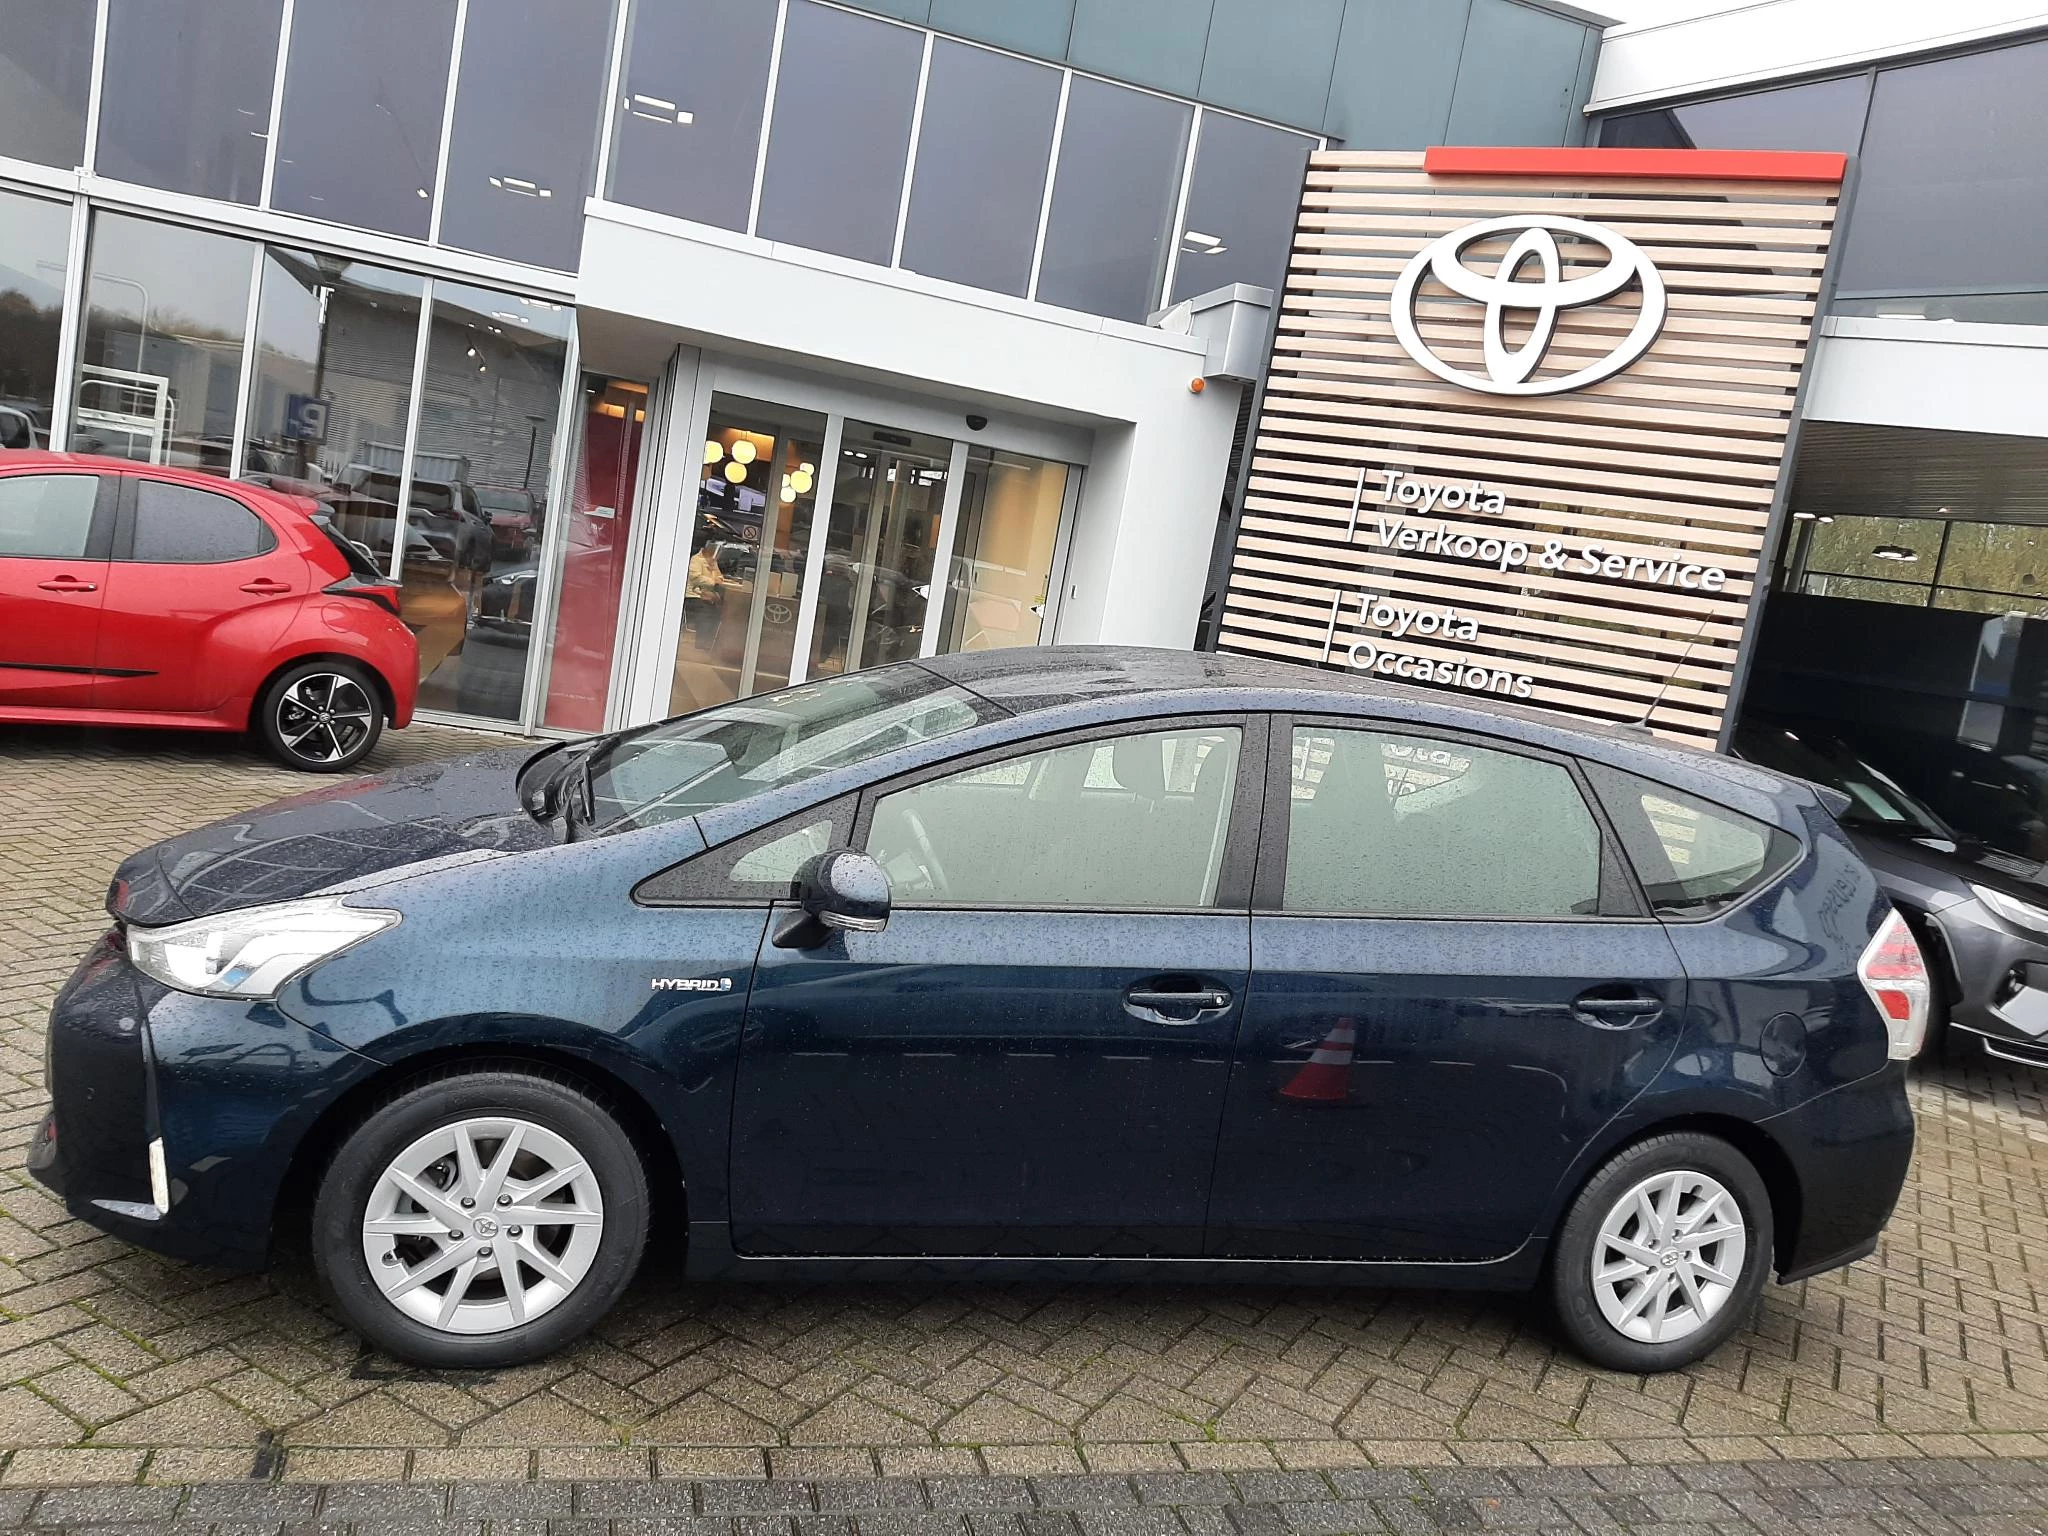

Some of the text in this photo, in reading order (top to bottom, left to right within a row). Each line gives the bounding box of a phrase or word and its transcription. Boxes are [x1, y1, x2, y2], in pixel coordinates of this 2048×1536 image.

[1381, 469, 1507, 515] Toyota
[1377, 518, 1726, 592] Verkoop & Service
[1356, 592, 1480, 642] Toyota
[1347, 640, 1534, 699] Occasions
[651, 978, 720, 991] HYBRID
